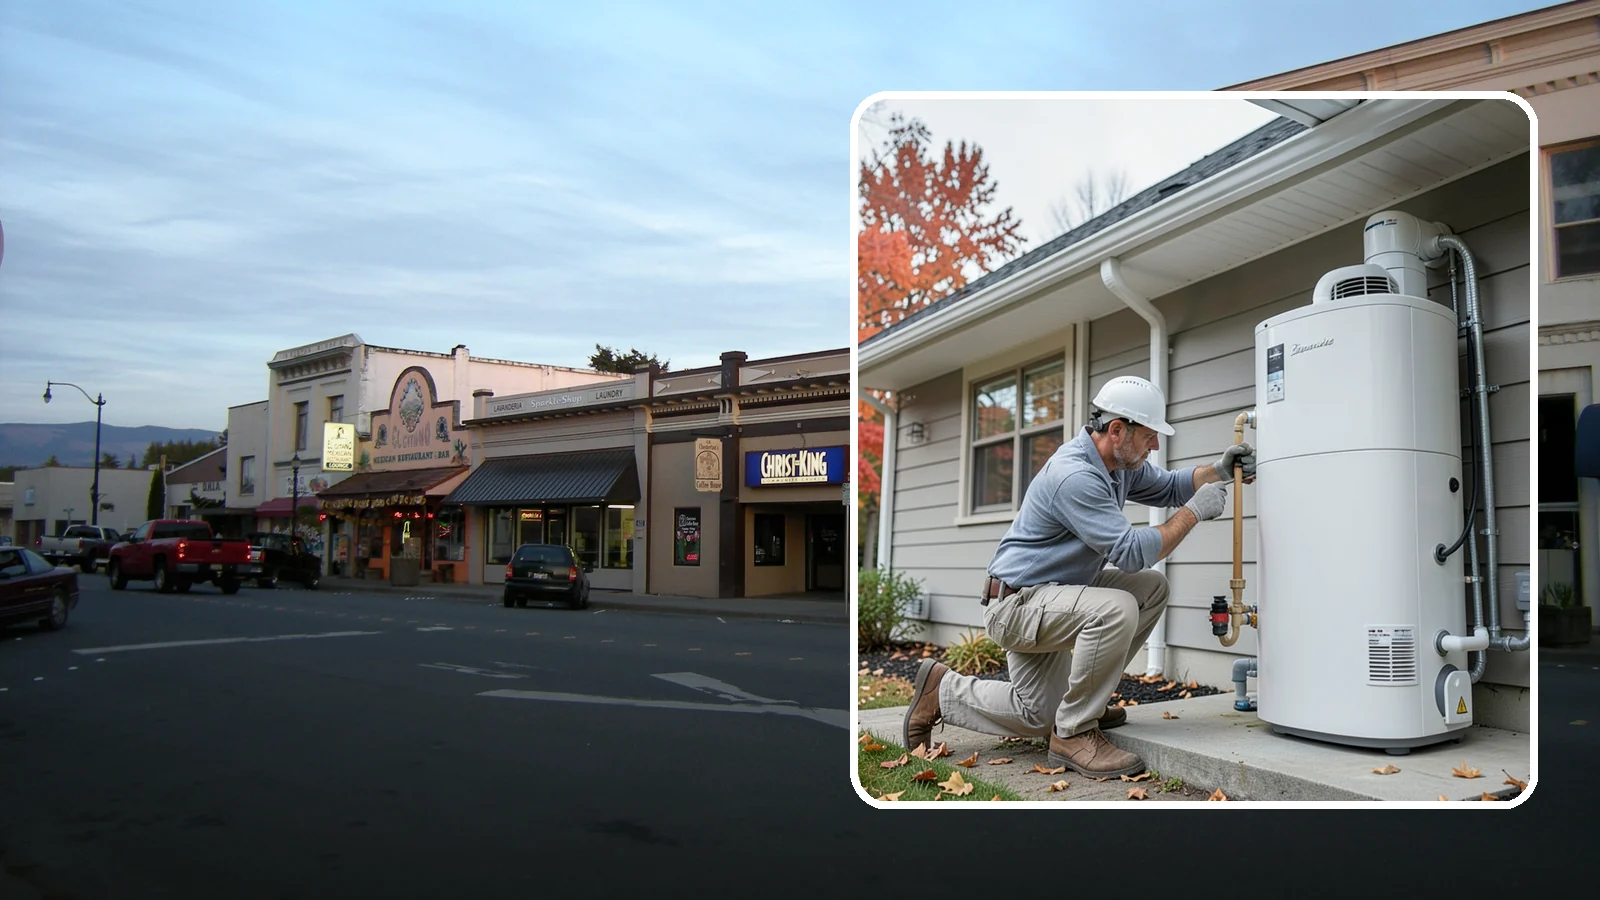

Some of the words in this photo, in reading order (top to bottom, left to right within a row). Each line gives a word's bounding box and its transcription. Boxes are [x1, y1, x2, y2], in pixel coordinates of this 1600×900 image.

[493, 402, 523, 412] LAVANDERIA
[530, 398, 560, 409] Sparkle
[561, 394, 583, 406] Shop
[595, 389, 623, 400] LAUNDRY
[373, 454, 396, 464] MEXICAN
[397, 451, 433, 463] RESTAURANT
[437, 450, 450, 459] BAR
[760, 452, 797, 478] CHRIST
[799, 450, 828, 477] KING
